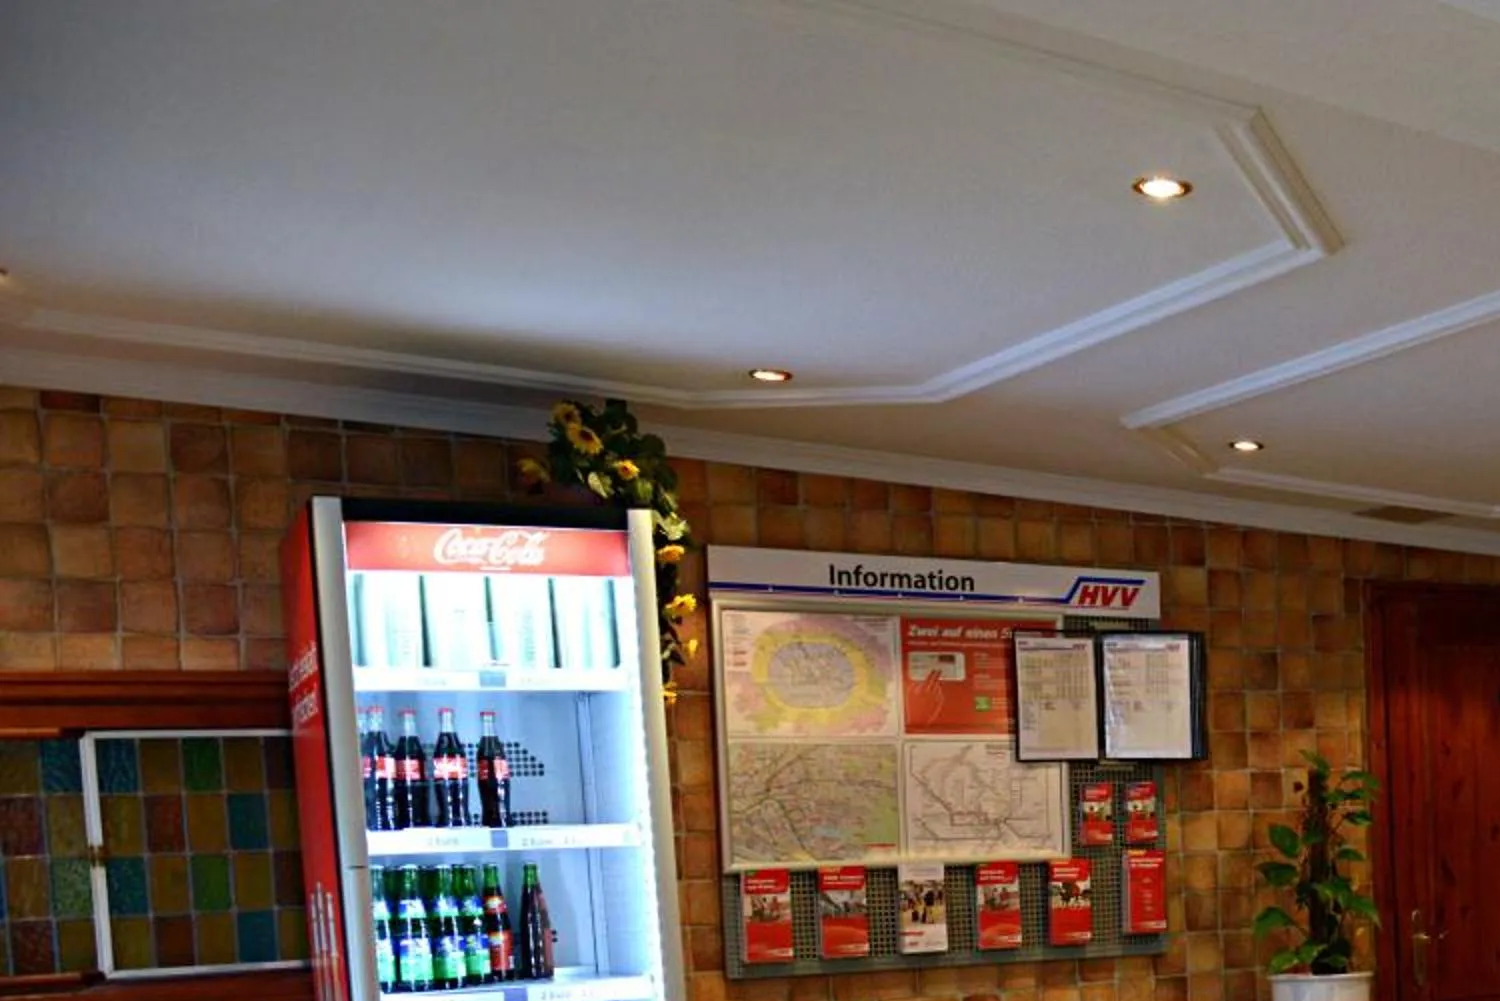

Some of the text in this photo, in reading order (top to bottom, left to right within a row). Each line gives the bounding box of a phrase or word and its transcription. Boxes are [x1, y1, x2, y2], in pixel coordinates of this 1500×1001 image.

[828, 564, 975, 593] Information
[1077, 585, 1140, 607] HVV
[907, 624, 939, 637] Zwei
[941, 626, 963, 638] auf
[965, 627, 998, 640] einen
